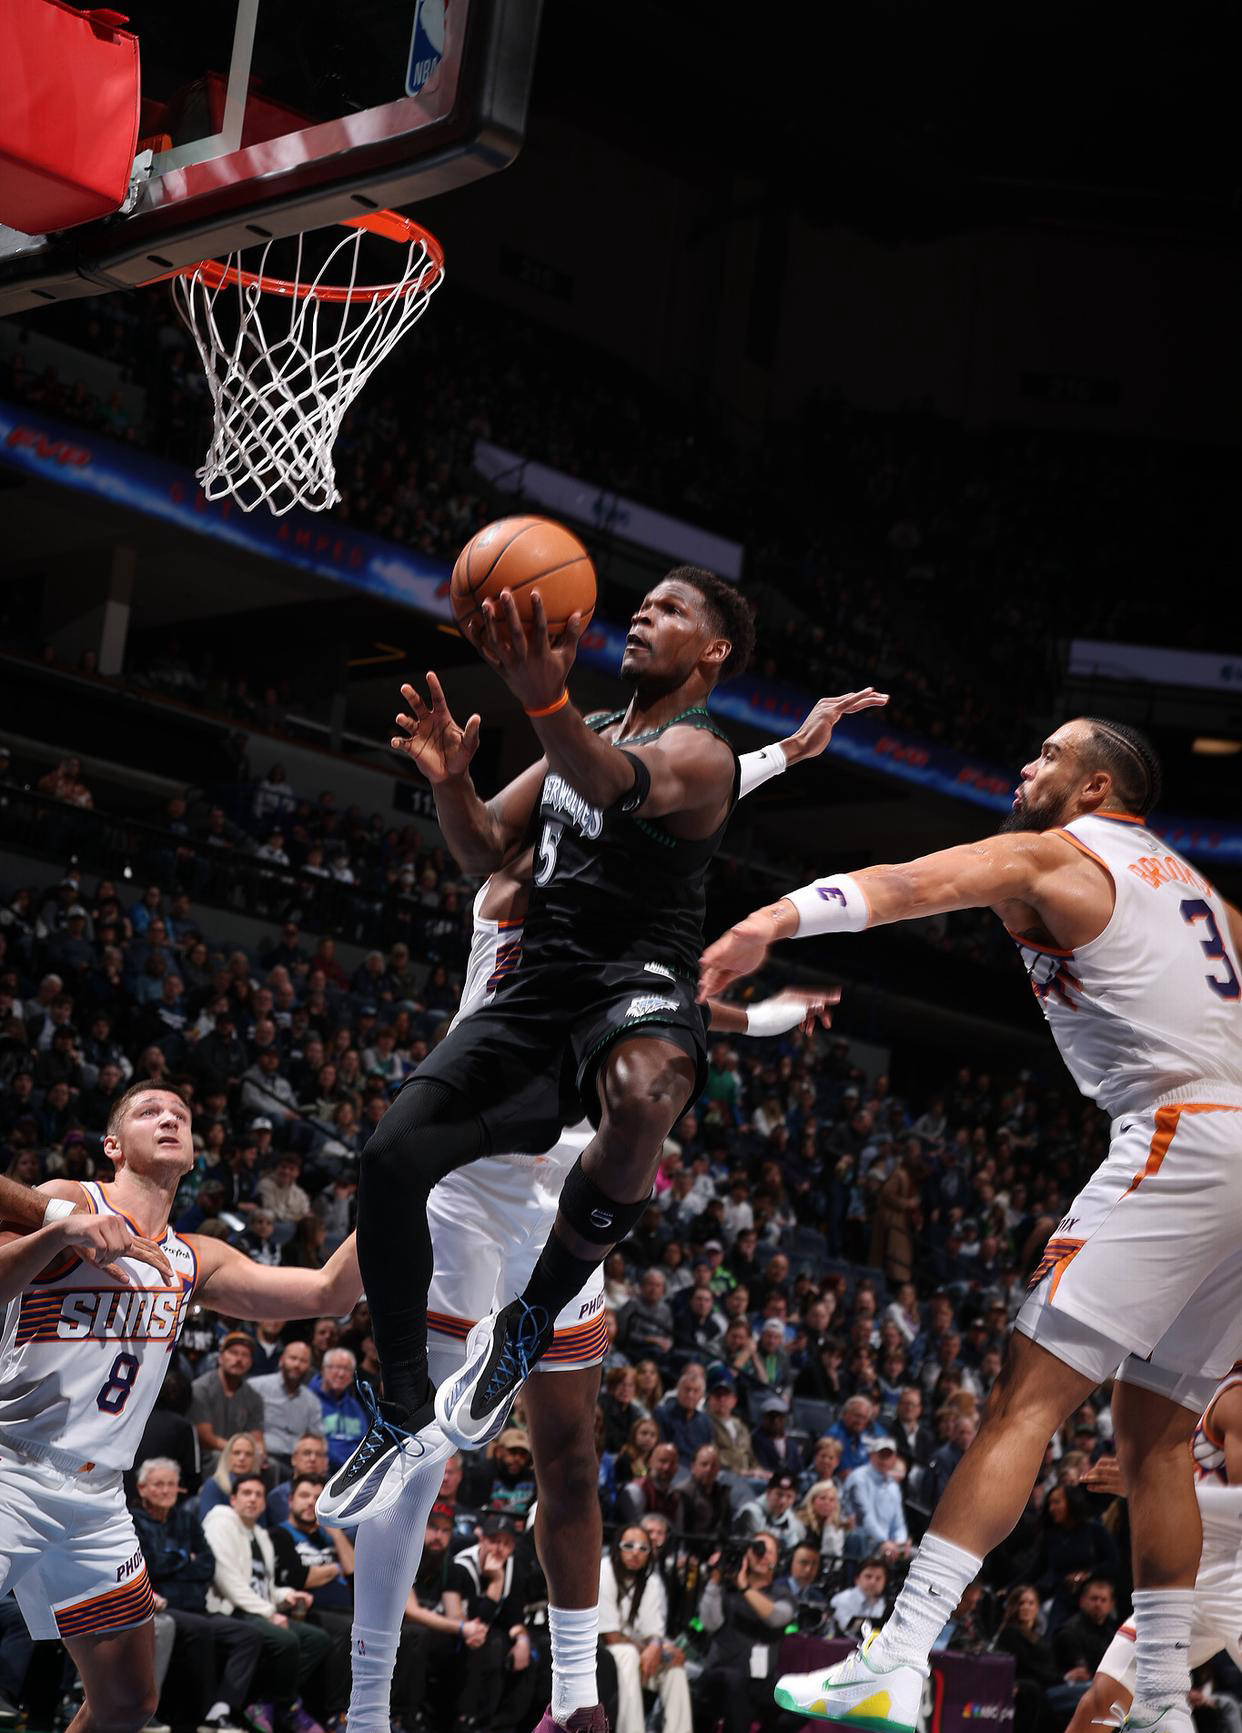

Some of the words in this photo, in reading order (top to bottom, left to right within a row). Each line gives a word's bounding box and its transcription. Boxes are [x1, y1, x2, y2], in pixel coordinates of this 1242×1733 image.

[541, 774, 604, 840] ERWOLVES
[535, 821, 565, 888] 5
[1180, 899, 1241, 1003] 3
[56, 1291, 180, 1340] SUNS
[97, 1352, 140, 1416] 8
